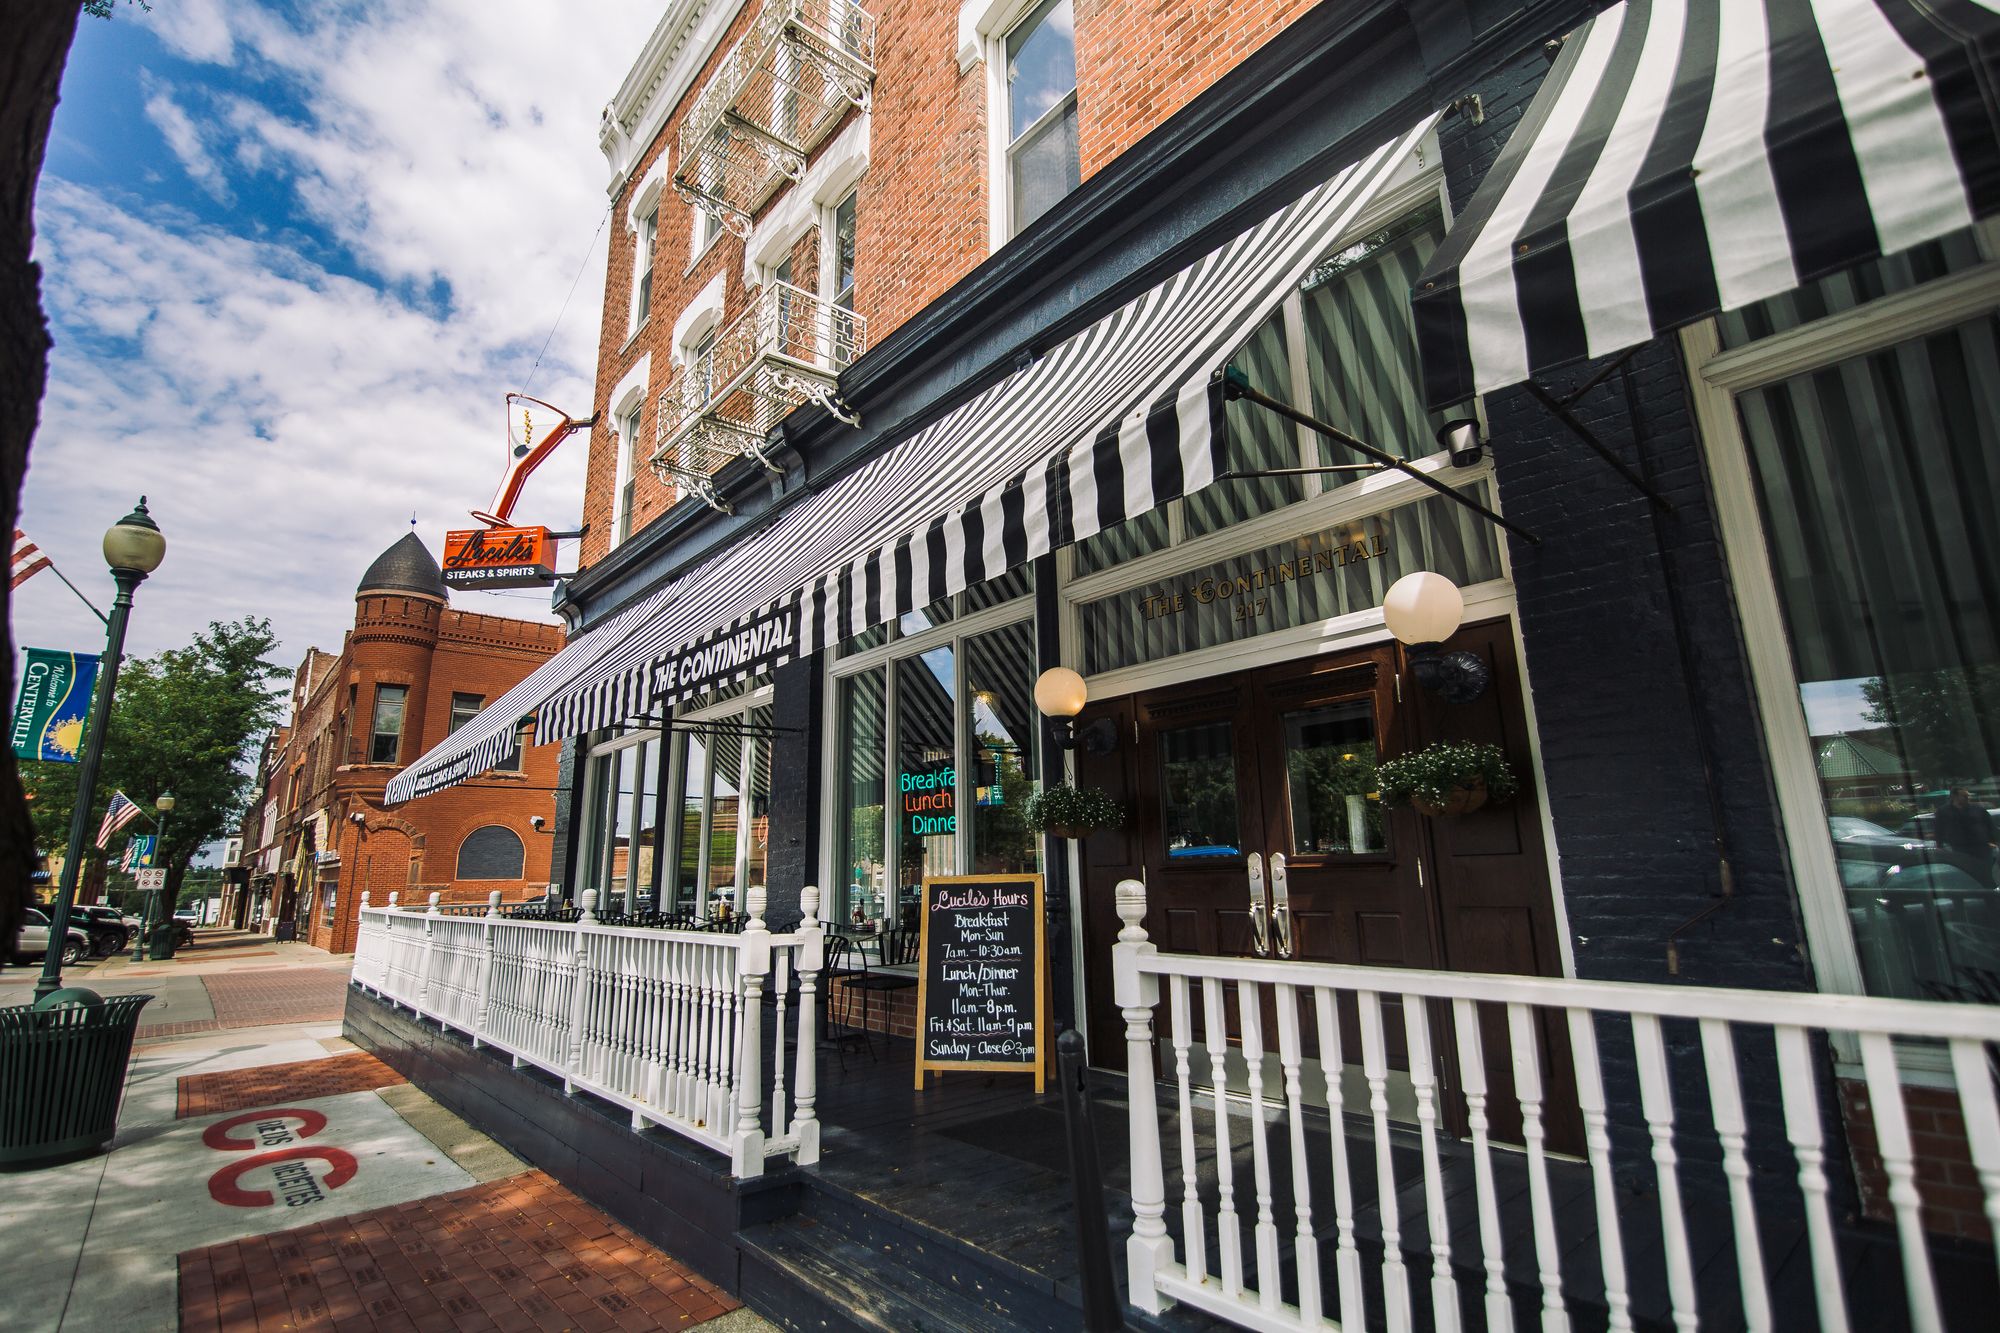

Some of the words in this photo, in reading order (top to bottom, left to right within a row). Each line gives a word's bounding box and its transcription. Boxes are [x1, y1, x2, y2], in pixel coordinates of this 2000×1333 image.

[446, 530, 533, 566] Lucile's
[446, 569, 485, 580] STEAKS
[487, 569, 495, 578] &
[496, 567, 535, 577] SPIRITS
[1139, 589, 1184, 621] THE
[1191, 535, 1388, 605] CONTINENTAL
[1235, 598, 1268, 622] 217
[652, 660, 677, 694] THE
[679, 612, 793, 686] CONTINENTAL
[47, 664, 65, 698] Welcome
[10, 662, 49, 748] CENTERVILLE
[45, 698, 57, 707] to
[901, 767, 956, 792] Breakfa
[905, 789, 952, 812] Lunch
[912, 815, 957, 835] Dinne
[931, 888, 990, 911] Lucile's
[993, 889, 1028, 906] Hours
[954, 911, 1010, 928] Breakfast
[961, 928, 1004, 942] Mon-Sun
[943, 963, 1019, 983] Lunch/Dinner
[256, 1119, 294, 1146] REDS
[272, 1162, 325, 1207] REDETTES
